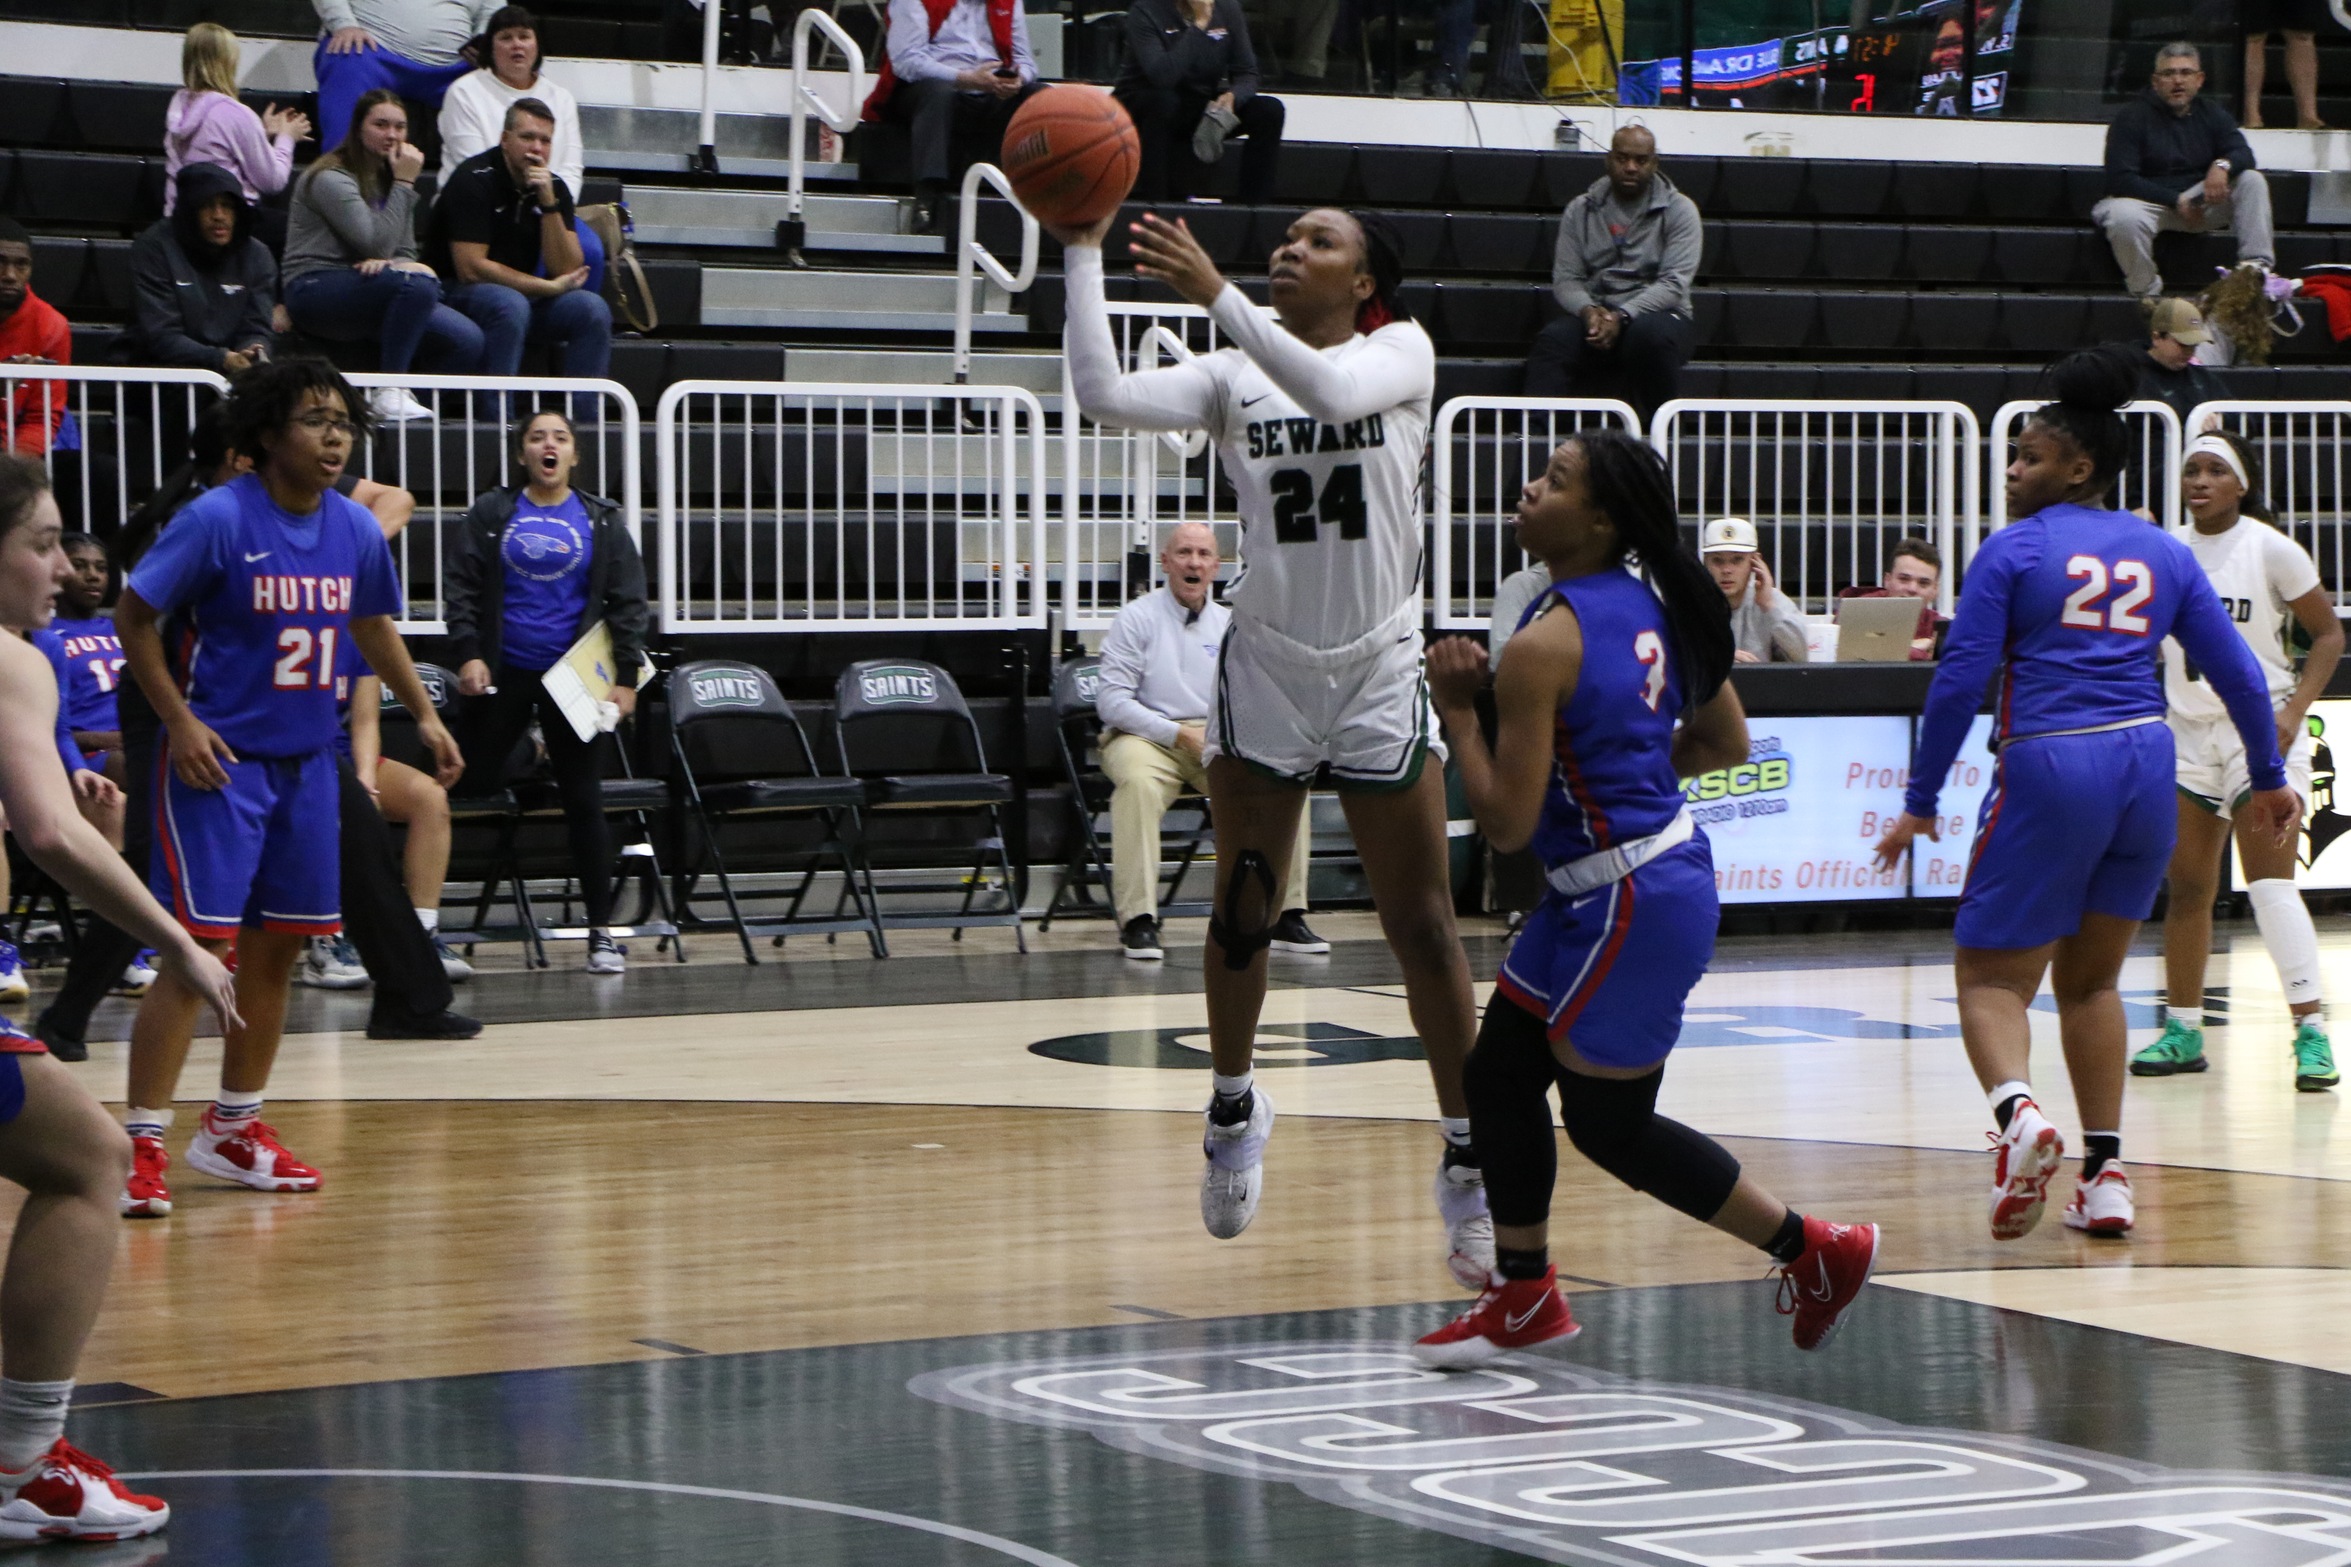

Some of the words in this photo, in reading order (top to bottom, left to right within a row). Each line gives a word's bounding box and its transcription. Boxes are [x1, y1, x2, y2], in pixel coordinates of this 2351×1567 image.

[1247, 412, 1386, 459] SEWARD
[1270, 464, 1368, 544] 24
[253, 575, 352, 614] HUTCH
[2061, 554, 2154, 637] 22
[64, 635, 123, 659] HUT
[273, 625, 338, 690] 21
[694, 677, 761, 701] SAINTS
[863, 675, 936, 698] SAINTS
[1632, 629, 1667, 714] 3
[1845, 762, 1911, 789] Prou
[1950, 760, 1981, 788] To
[1714, 862, 1783, 891] aints
